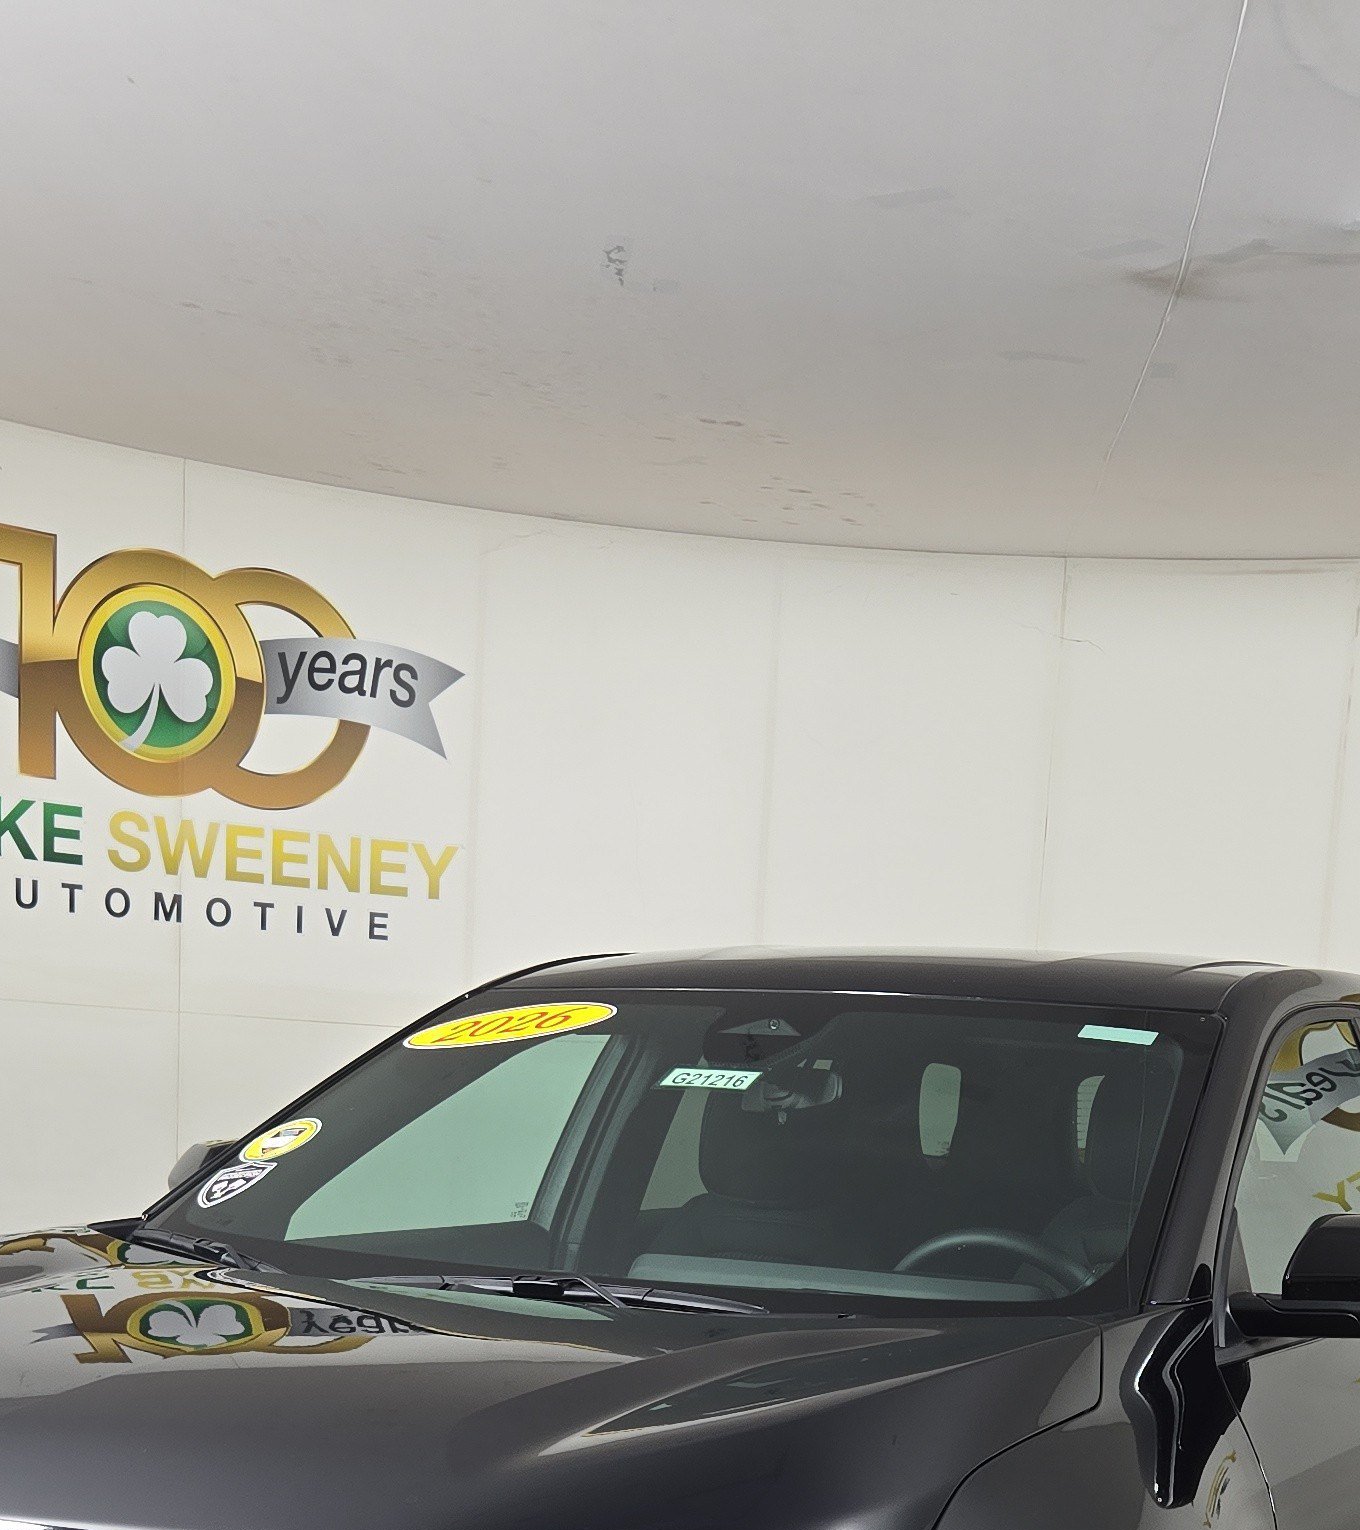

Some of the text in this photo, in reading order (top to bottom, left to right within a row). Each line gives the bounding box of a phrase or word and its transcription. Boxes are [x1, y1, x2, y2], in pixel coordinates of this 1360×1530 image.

[275, 647, 419, 709] years
[107, 810, 459, 900] SWEENEY
[429, 1006, 589, 1044] 2026
[671, 1071, 749, 1088] G21216
